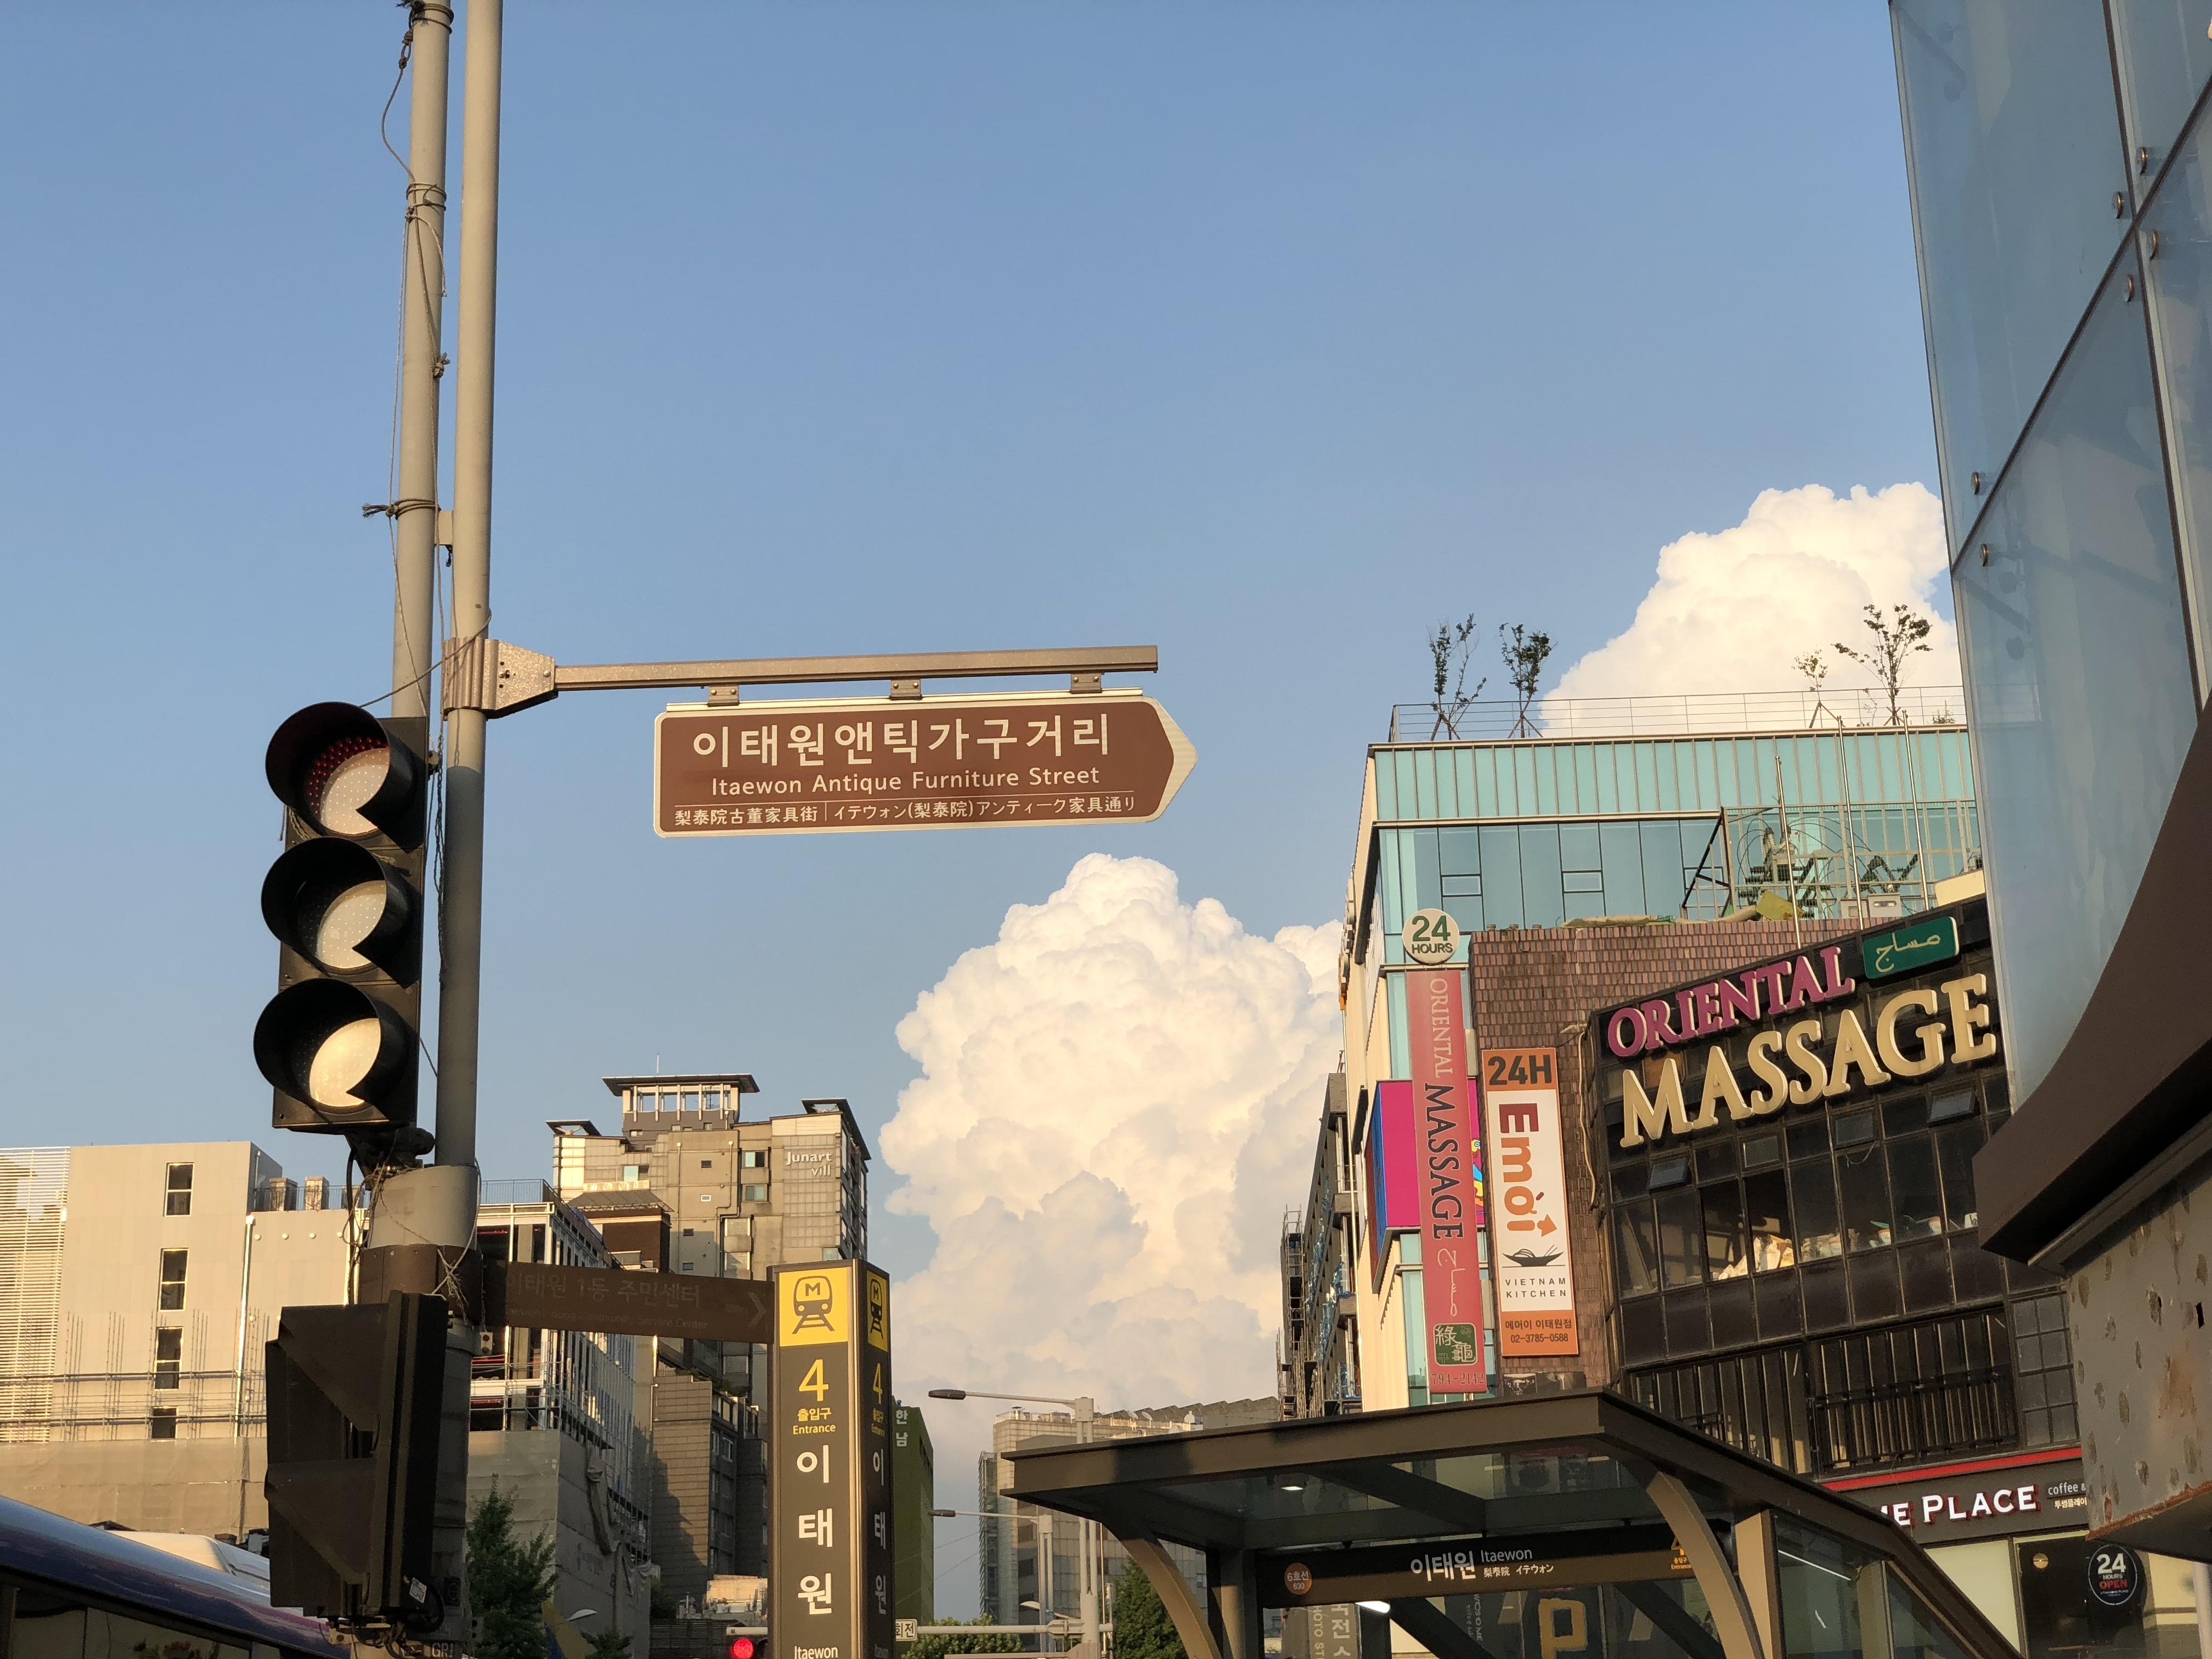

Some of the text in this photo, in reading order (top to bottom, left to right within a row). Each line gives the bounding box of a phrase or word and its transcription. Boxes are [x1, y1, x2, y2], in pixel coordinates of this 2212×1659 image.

[693, 713, 1109, 768] 이태원앤틱가구거리
[712, 766, 1099, 796] Itaewon Antique Furniture Street
[675, 806, 818, 826] 梨泰院古董家具街
[1412, 915, 1451, 941] 24
[1411, 943, 1453, 954] HOURS
[1607, 946, 1855, 1058] ORIENTAL
[1620, 973, 1997, 1148] MASSAGE
[1487, 1054, 1553, 1086] 24H
[1425, 977, 1464, 1240] ORIENTAL MASSAGE
[786, 1151, 832, 1166] Junart
[811, 1164, 831, 1177] vill
[1505, 1277, 1566, 1286] VIETNAM
[805, 1283, 821, 1297] M
[1506, 1289, 1567, 1298] KITCHEN
[1505, 1319, 1572, 1330] 에머이 이태원점
[1510, 1333, 1568, 1344] 02-3785-0588
[798, 1358, 830, 1402] 4
[873, 1363, 883, 1404] 4
[1431, 1373, 1484, 1385] 794-2142
[797, 1407, 832, 1421] 출입구
[793, 1424, 837, 1435] Entrance
[2048, 1482, 2078, 1496] coffee
[1921, 1485, 2036, 1523] PLACE
[1481, 1549, 1533, 1562] Itaewon
[1410, 1550, 1476, 1582] 이태원
[2097, 1553, 2126, 1575] 24
[1287, 1570, 1310, 1582] 6호선
[1293, 1582, 1305, 1590] 630
[2098, 1579, 2128, 1589] OPEN
[794, 1645, 838, 1659] Itaewon
